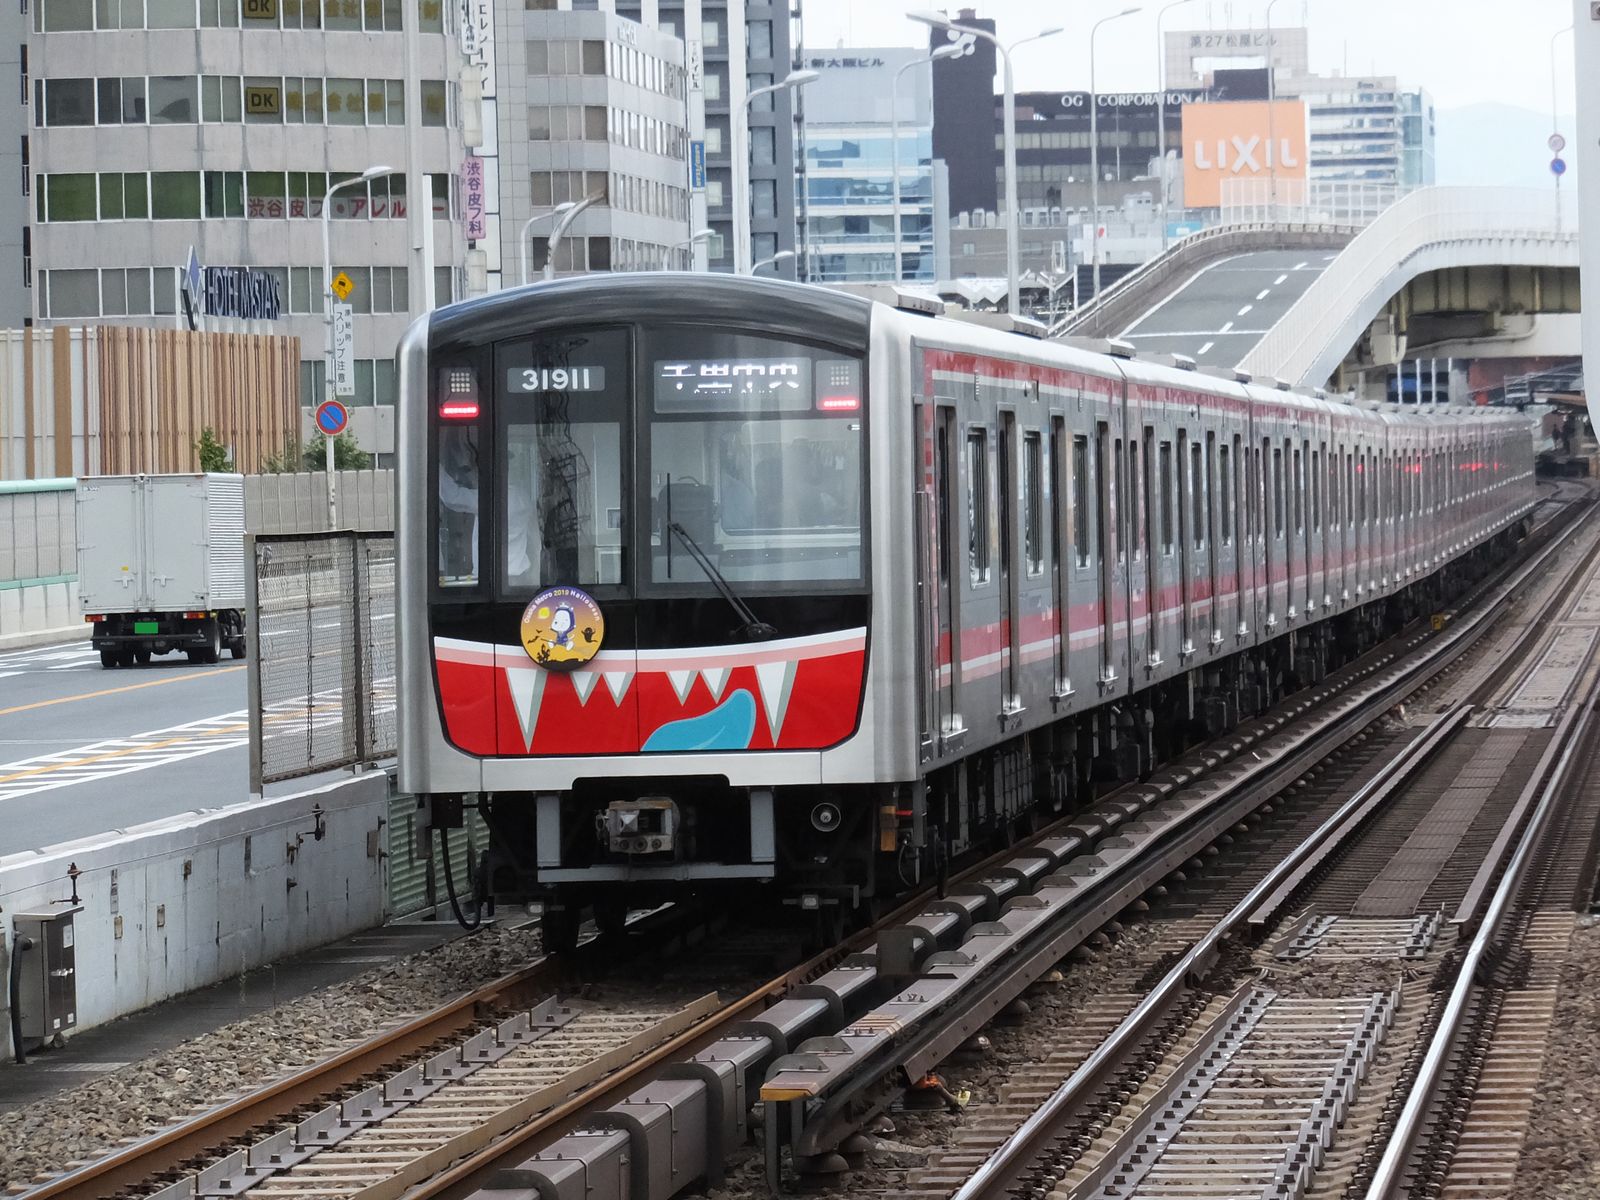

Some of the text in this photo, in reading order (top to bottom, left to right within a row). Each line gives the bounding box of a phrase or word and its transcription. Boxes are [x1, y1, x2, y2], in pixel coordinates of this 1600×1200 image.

[247, 0, 271, 12] DK
[804, 58, 885, 68] 新大阪ビル
[250, 93, 274, 108] DK
[1061, 94, 1084, 107] OG
[1097, 91, 1192, 108] CORPORATION
[1194, 135, 1298, 175] LIXIL
[467, 161, 483, 235] 渋谷皮フ科
[249, 199, 445, 218] 渋谷皮フ・アレルー
[522, 368, 590, 391] 31911
[535, 592, 553, 605] Metro
[570, 590, 600, 622] Halloween
